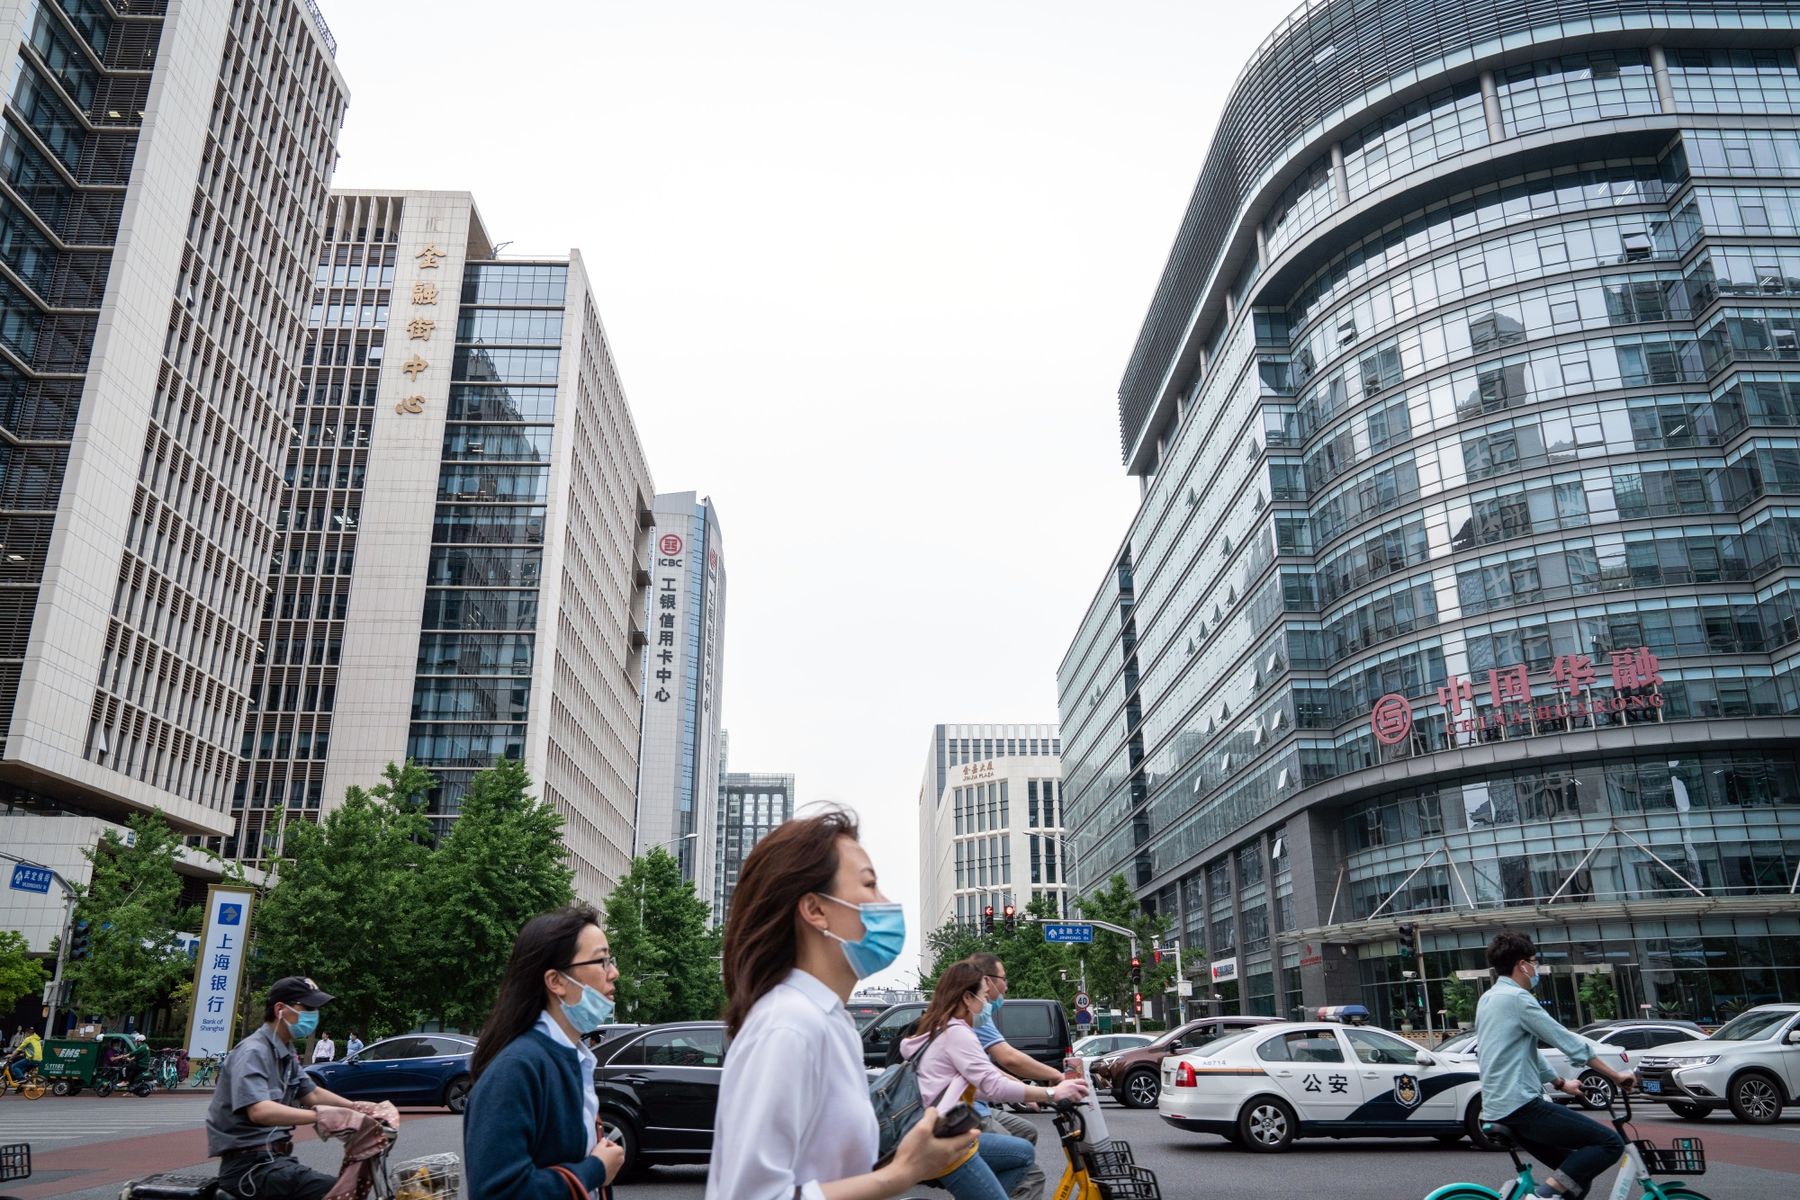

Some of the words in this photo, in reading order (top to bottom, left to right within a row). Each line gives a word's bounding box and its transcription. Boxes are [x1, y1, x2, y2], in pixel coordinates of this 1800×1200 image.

[396, 241, 447, 415] 金融街中心
[658, 558, 683, 568] ICBC
[655, 577, 677, 703] 工银信用卡中心
[1437, 646, 1664, 717] 中国华融
[1446, 711, 1527, 736] CHINA
[1536, 693, 1664, 720] HUARONG
[207, 933, 233, 1013] 上海银行
[1078, 997, 1088, 1006] 40
[200, 1025, 225, 1033] Shanghai
[58, 1048, 81, 1058] EMS
[1302, 1073, 1348, 1094] 公安
